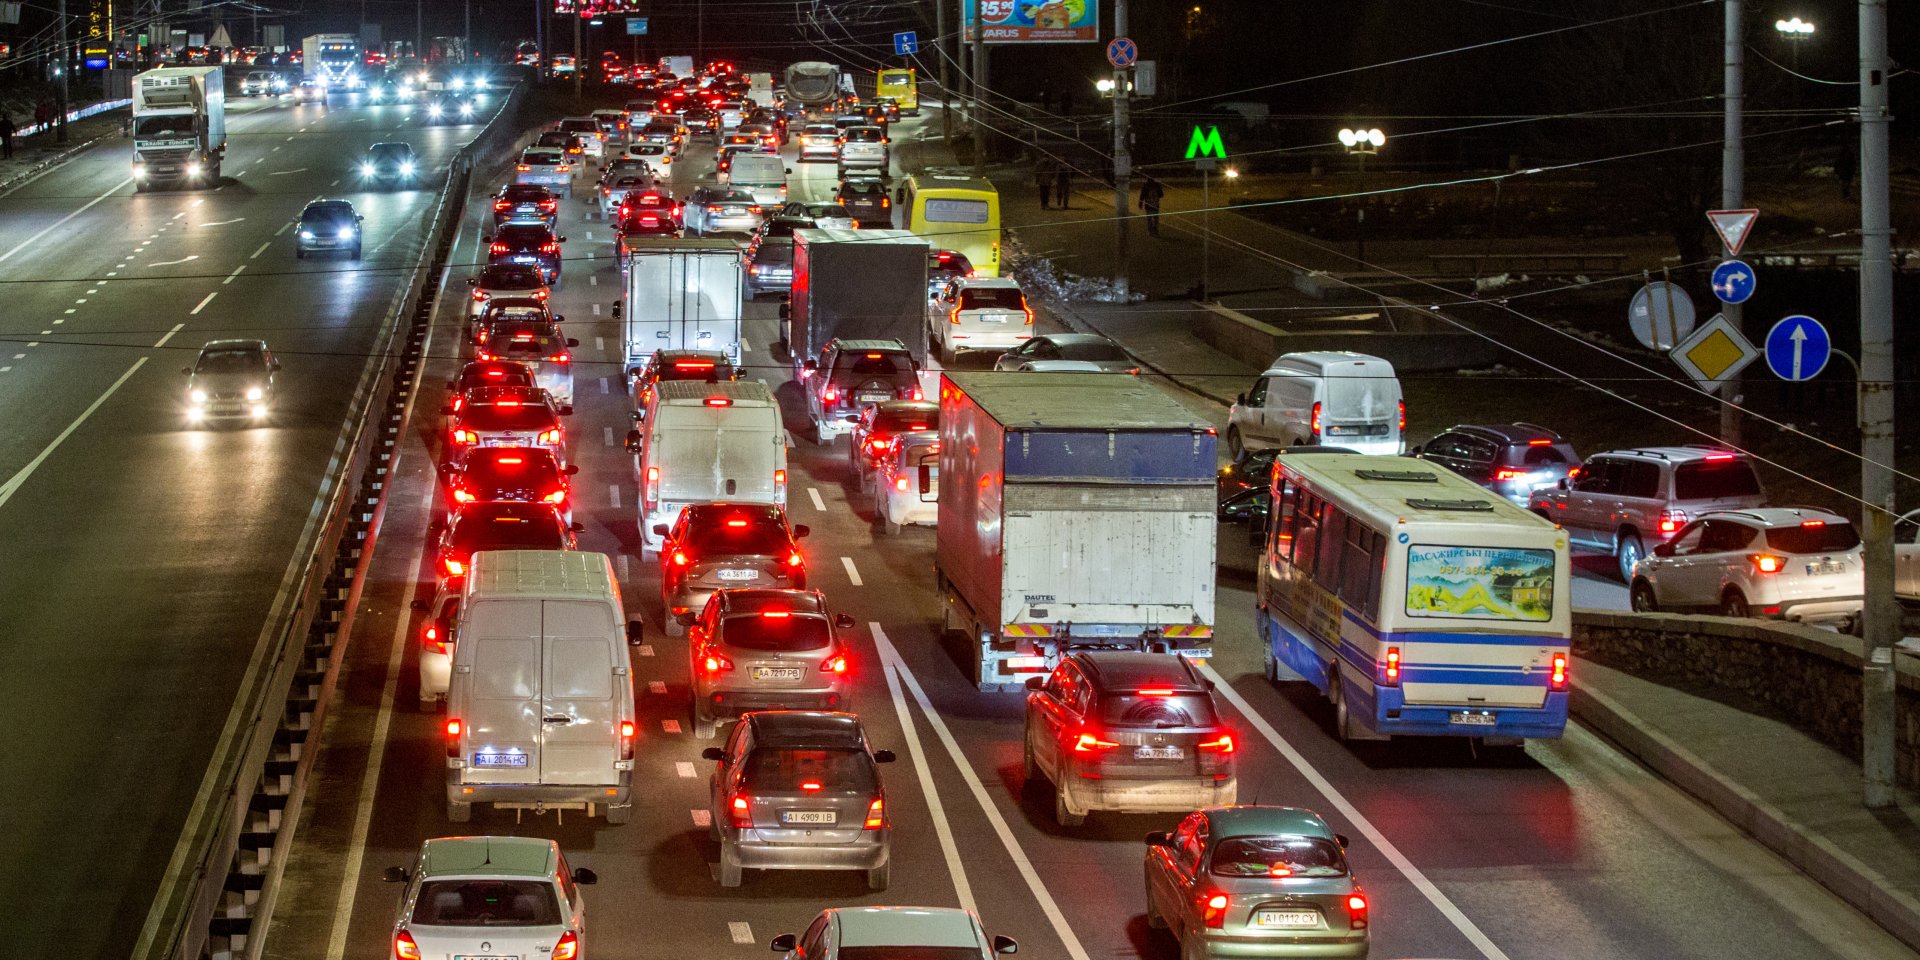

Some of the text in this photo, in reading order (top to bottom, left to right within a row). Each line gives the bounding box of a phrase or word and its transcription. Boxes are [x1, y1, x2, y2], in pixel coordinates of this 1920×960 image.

[481, 756, 525, 764] AI 2014 HC
[1265, 914, 1315, 922] AI 0112 CX
